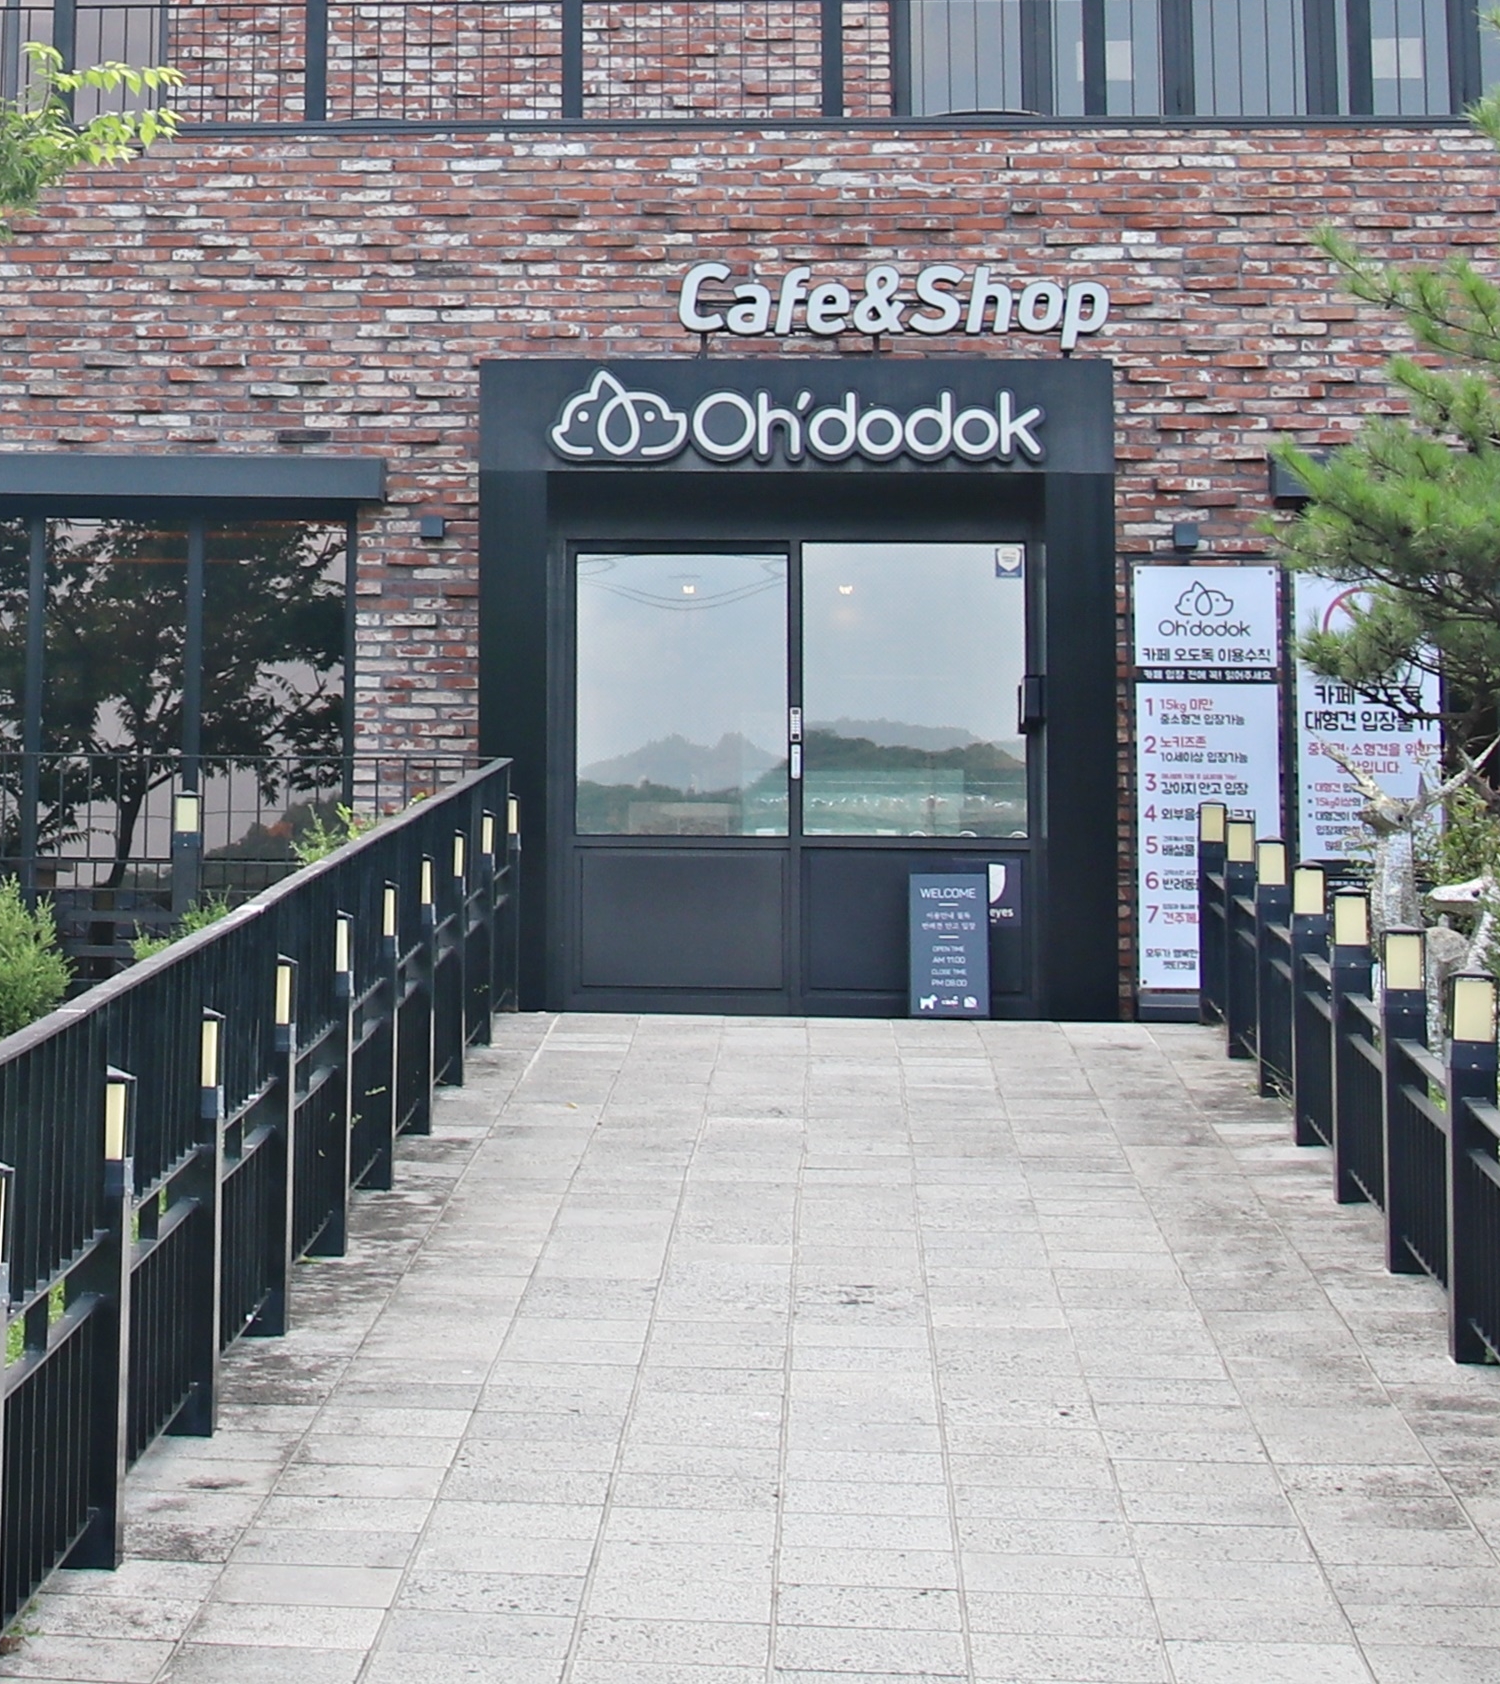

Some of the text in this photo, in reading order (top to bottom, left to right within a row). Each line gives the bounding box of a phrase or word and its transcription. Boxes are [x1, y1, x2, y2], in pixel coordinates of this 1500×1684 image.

[679, 262, 1109, 349] Cafe&Shop
[692, 390, 1044, 458] Oh'dodok
[1158, 619, 1251, 637] Oh'dodok
[1142, 647, 1271, 662] 카페 오도독 이용수칙
[1315, 685, 1355, 704] 카페
[1145, 698, 1154, 716] 1
[1160, 698, 1213, 713] 15kg 미만
[1204, 714, 1245, 725] 입장가능
[1305, 710, 1356, 731] 대형견
[1144, 736, 1157, 754] 2
[1160, 736, 1206, 748] 노키즈존
[1161, 752, 1203, 762] 10세이상
[1145, 773, 1157, 791] 3
[1160, 782, 1248, 795] 강아지 안고 입장
[1144, 805, 1157, 821] 4
[1161, 808, 1200, 821] 외부음
[1146, 836, 1158, 854] 5
[1146, 871, 1159, 889] 6
[1162, 878, 1200, 891] 반려동
[920, 888, 976, 899] WELCOME
[989, 908, 1014, 918] eyes
[1146, 905, 1159, 923] 7
